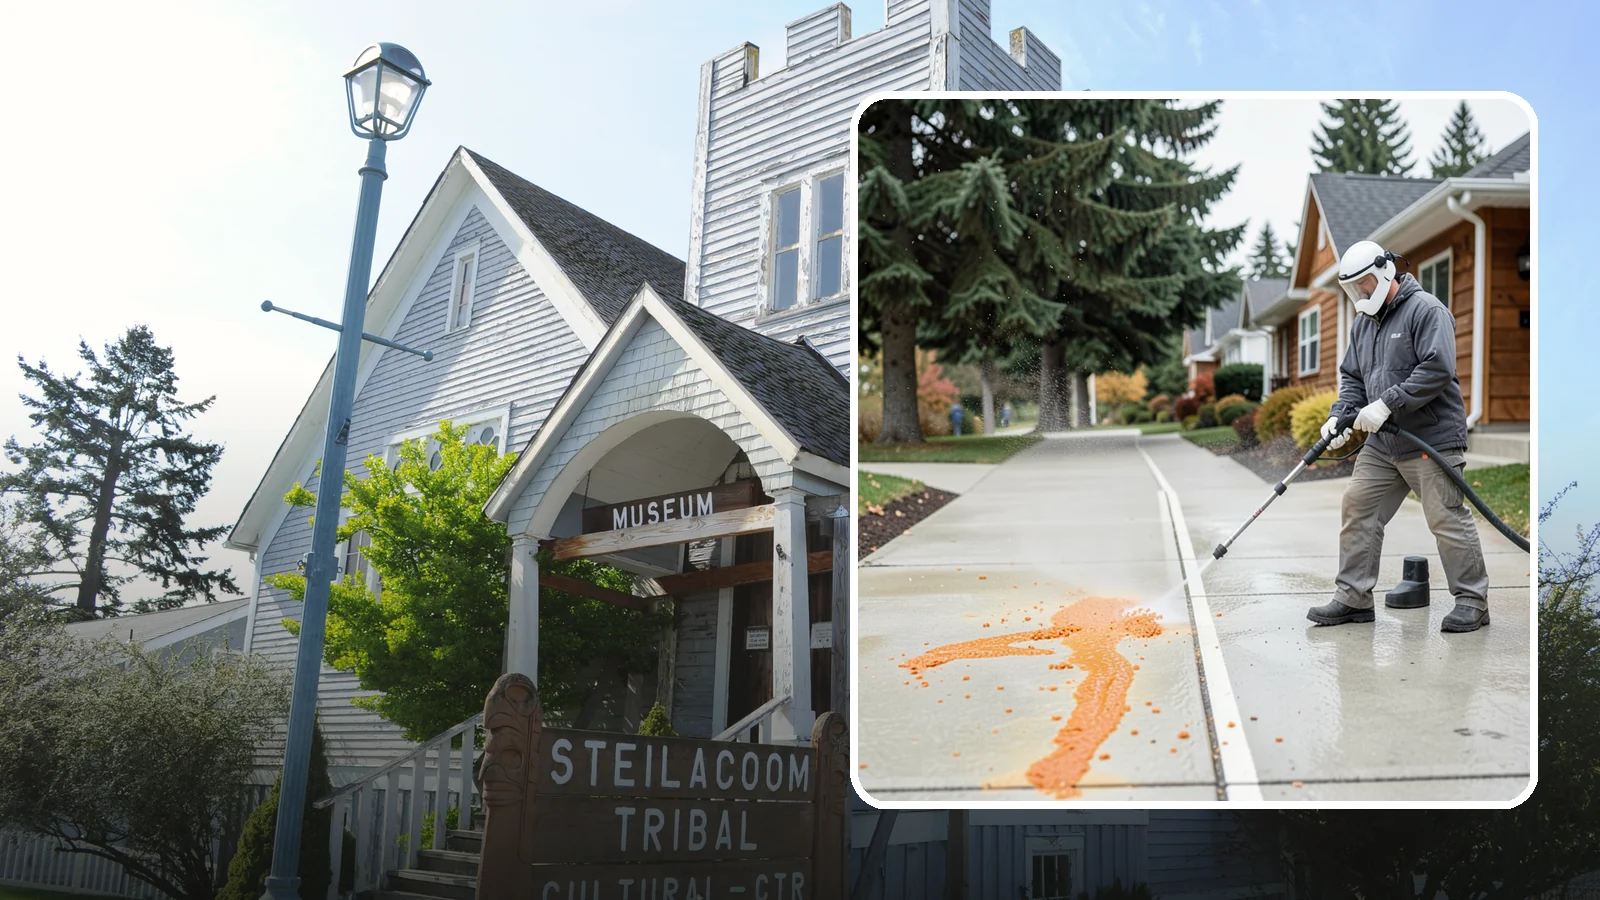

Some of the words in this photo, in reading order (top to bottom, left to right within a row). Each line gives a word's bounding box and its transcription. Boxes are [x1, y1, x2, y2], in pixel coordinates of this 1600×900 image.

[613, 491, 713, 531] MUSEUM
[550, 738, 810, 792] STEILACOOM
[614, 806, 758, 852] TRIBAL
